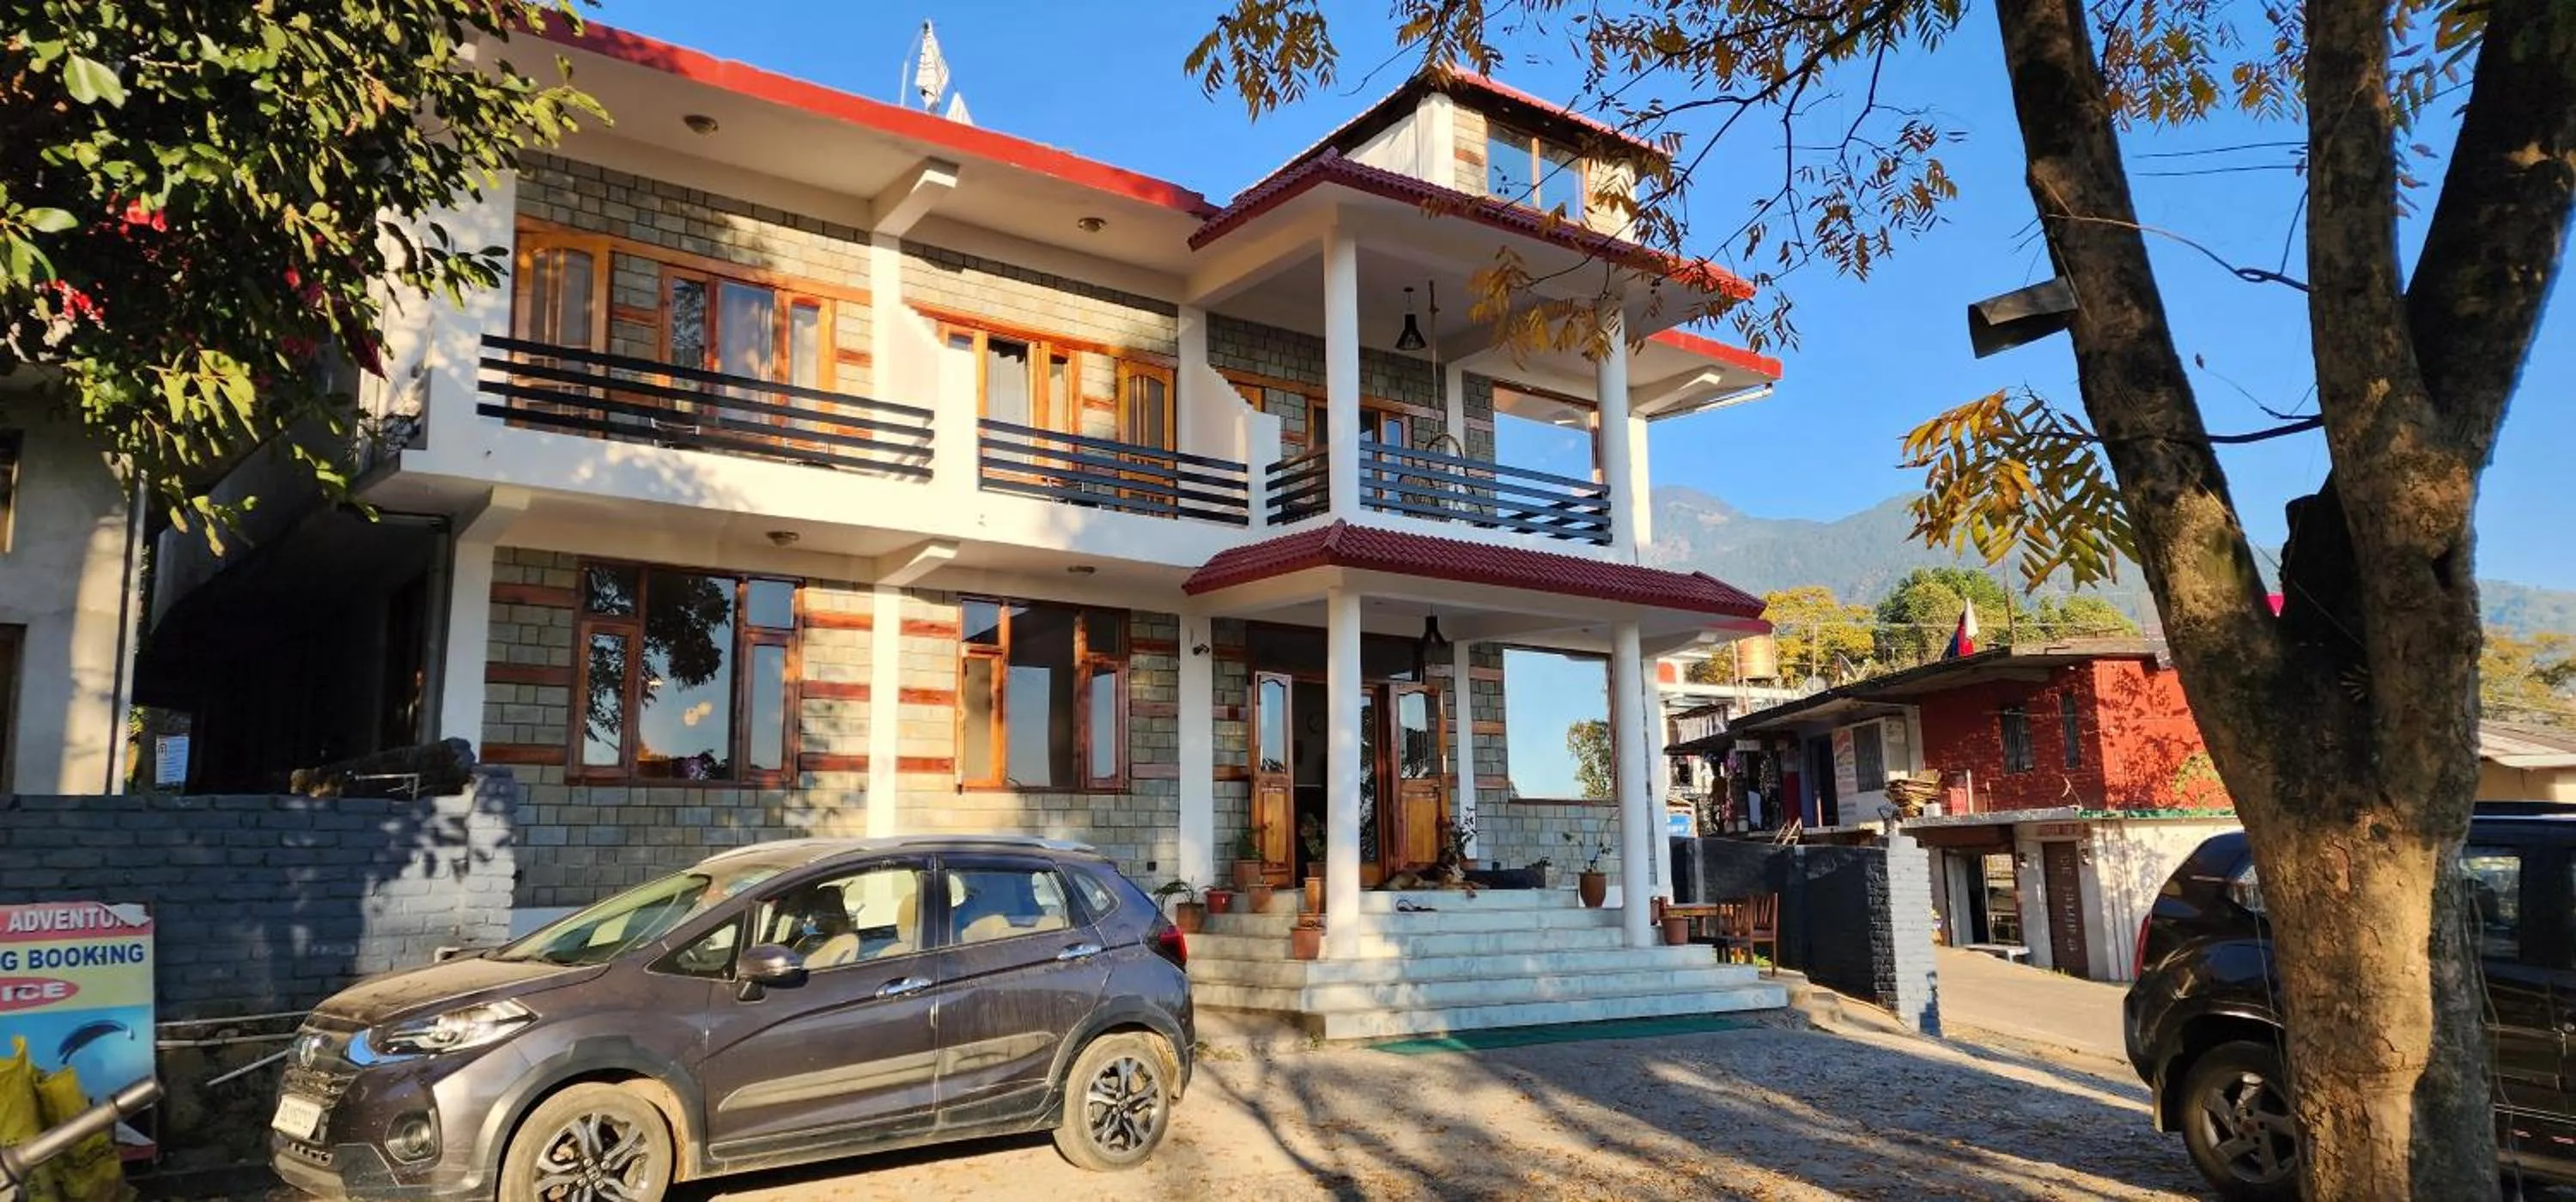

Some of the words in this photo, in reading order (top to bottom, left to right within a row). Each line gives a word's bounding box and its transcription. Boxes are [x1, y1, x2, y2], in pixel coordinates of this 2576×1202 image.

[8, 907, 140, 932] ADVENTU
[27, 944, 144, 969] BOOKING
[2, 982, 67, 1002] ICE
